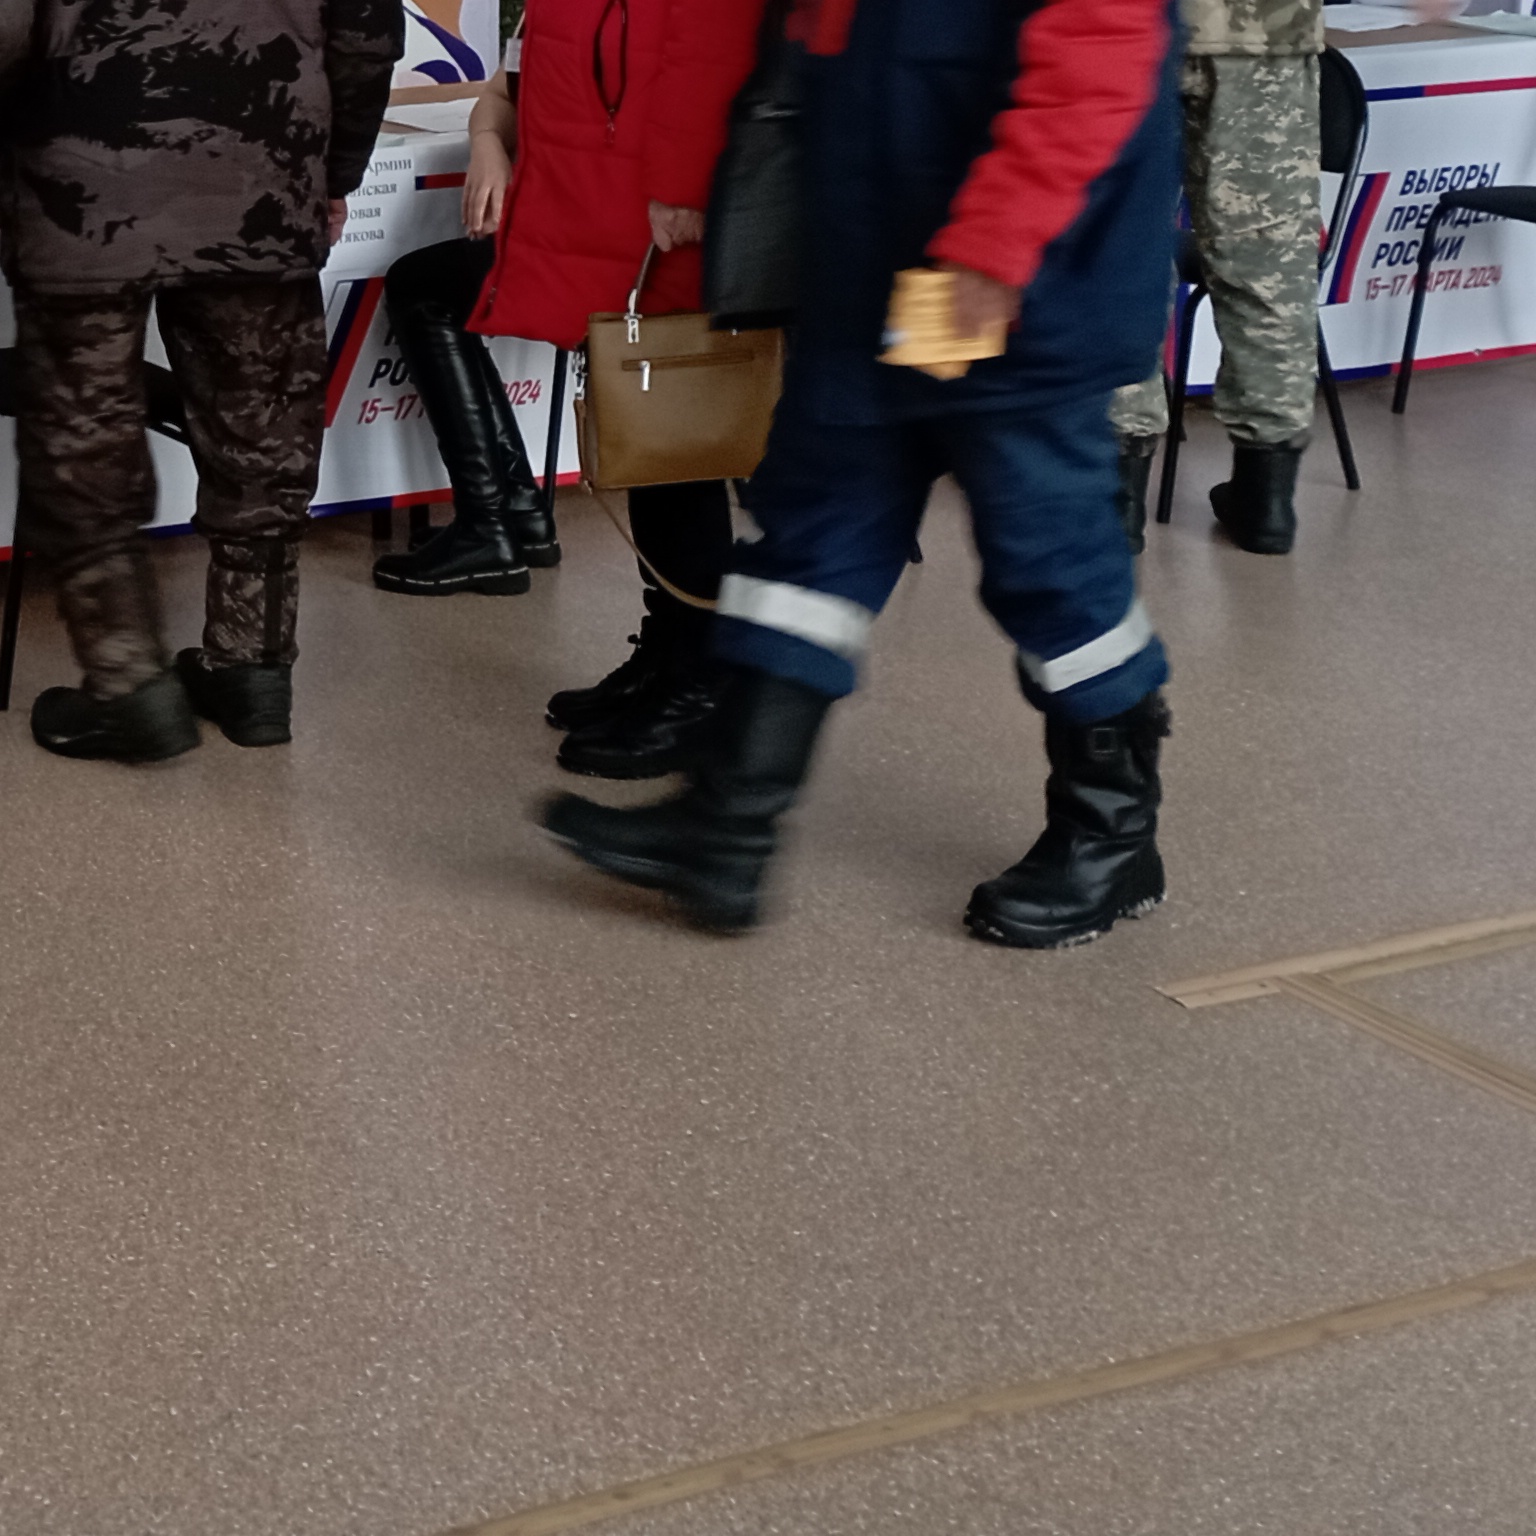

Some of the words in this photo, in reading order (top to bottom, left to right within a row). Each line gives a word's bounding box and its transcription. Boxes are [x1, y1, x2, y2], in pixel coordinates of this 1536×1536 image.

[1398, 163, 1501, 197] ВЫБОРЫ
[349, 207, 382, 220] овая
[1371, 236, 1466, 269] РОСИИ
[1462, 264, 1503, 290] 2024
